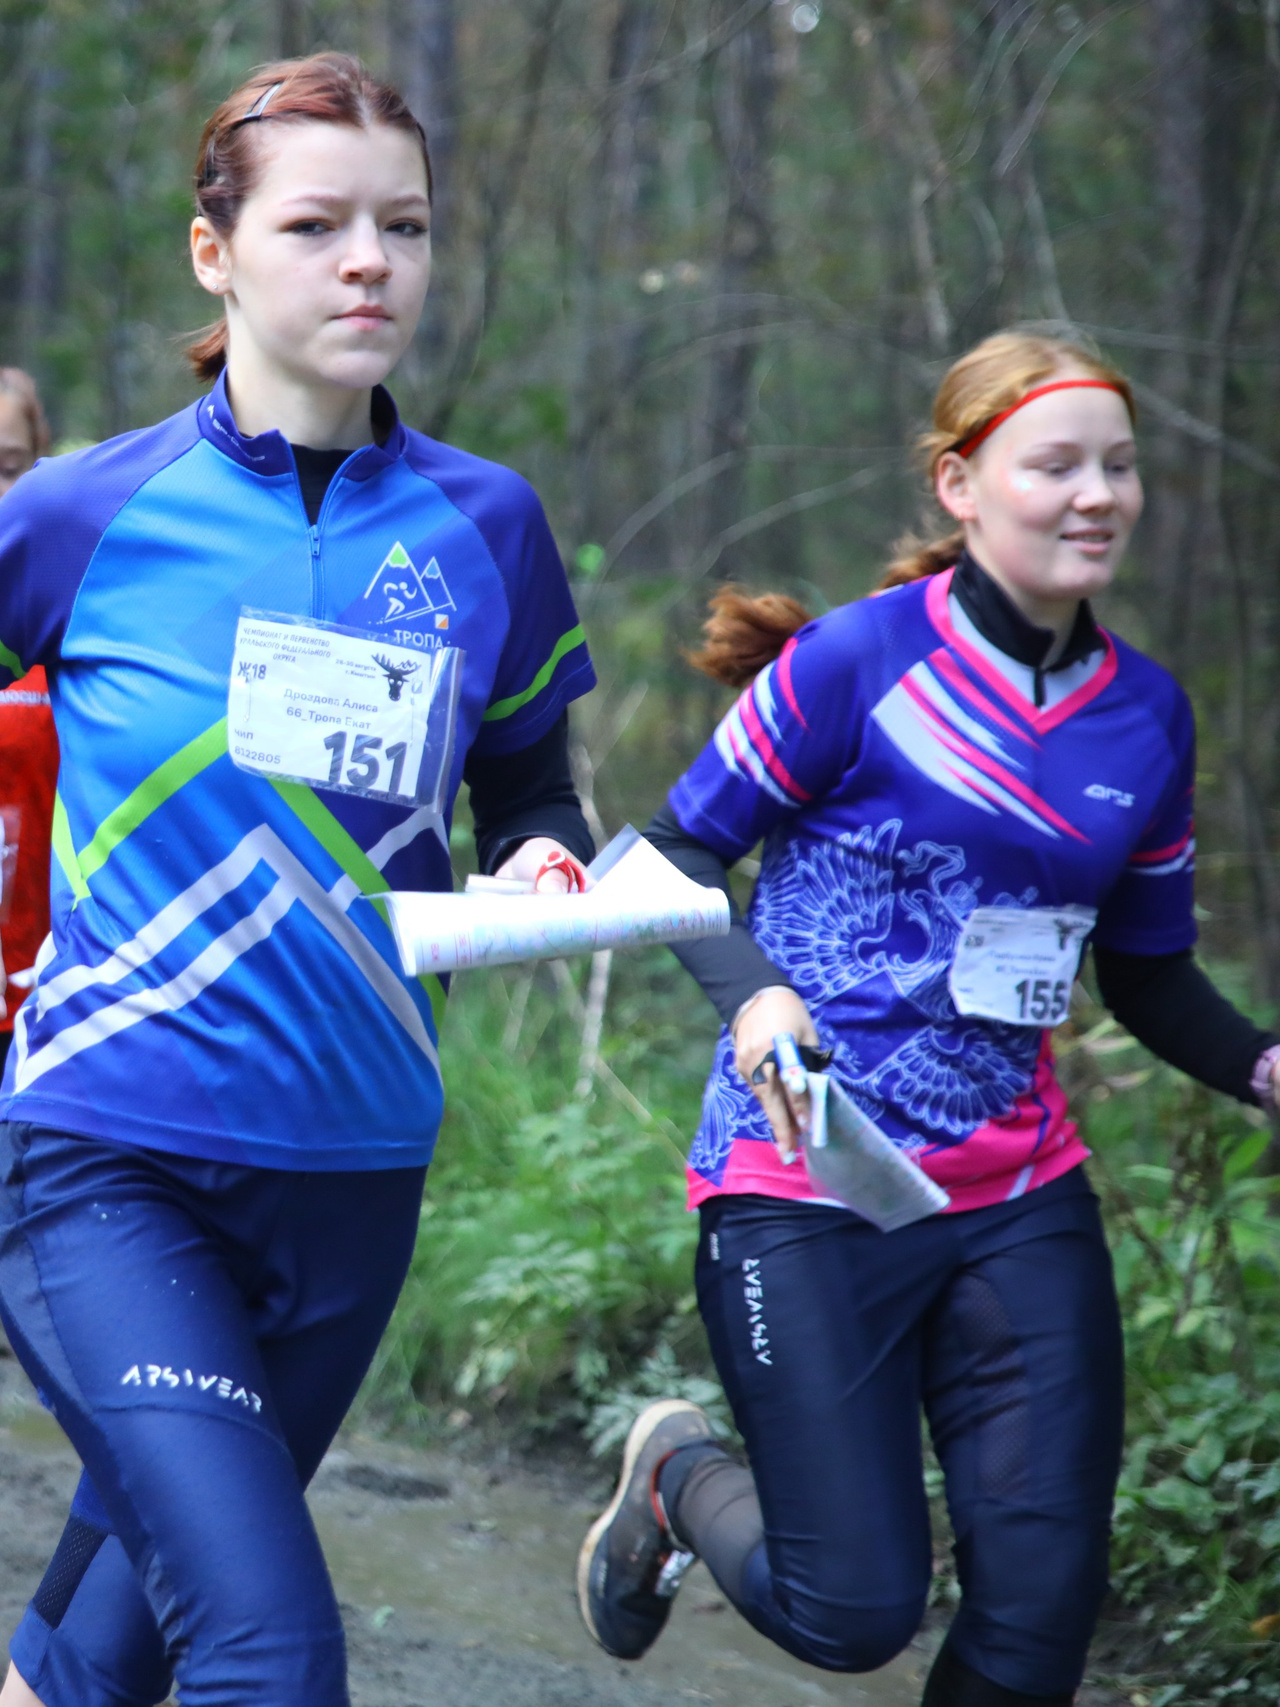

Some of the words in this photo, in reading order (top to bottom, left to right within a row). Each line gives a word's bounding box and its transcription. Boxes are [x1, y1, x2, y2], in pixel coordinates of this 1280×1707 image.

[239, 637, 280, 650] УРАЛЬСКОГО
[281, 643, 331, 658] ФЕДЕРАЛЬНОГО
[243, 627, 282, 640] ЧЕМПИОНАТ
[290, 635, 331, 648] ПЕРВЕНСТВО
[393, 629, 444, 650] ТРОПА
[272, 653, 296, 664] ОКРУГА
[237, 661, 267, 680] Ж18
[283, 688, 340, 706] Дроздова
[342, 698, 379, 713] Алиса
[345, 716, 372, 730] Екат
[234, 728, 254, 740] чип
[234, 745, 281, 765] 8122805
[323, 730, 408, 794] 151
